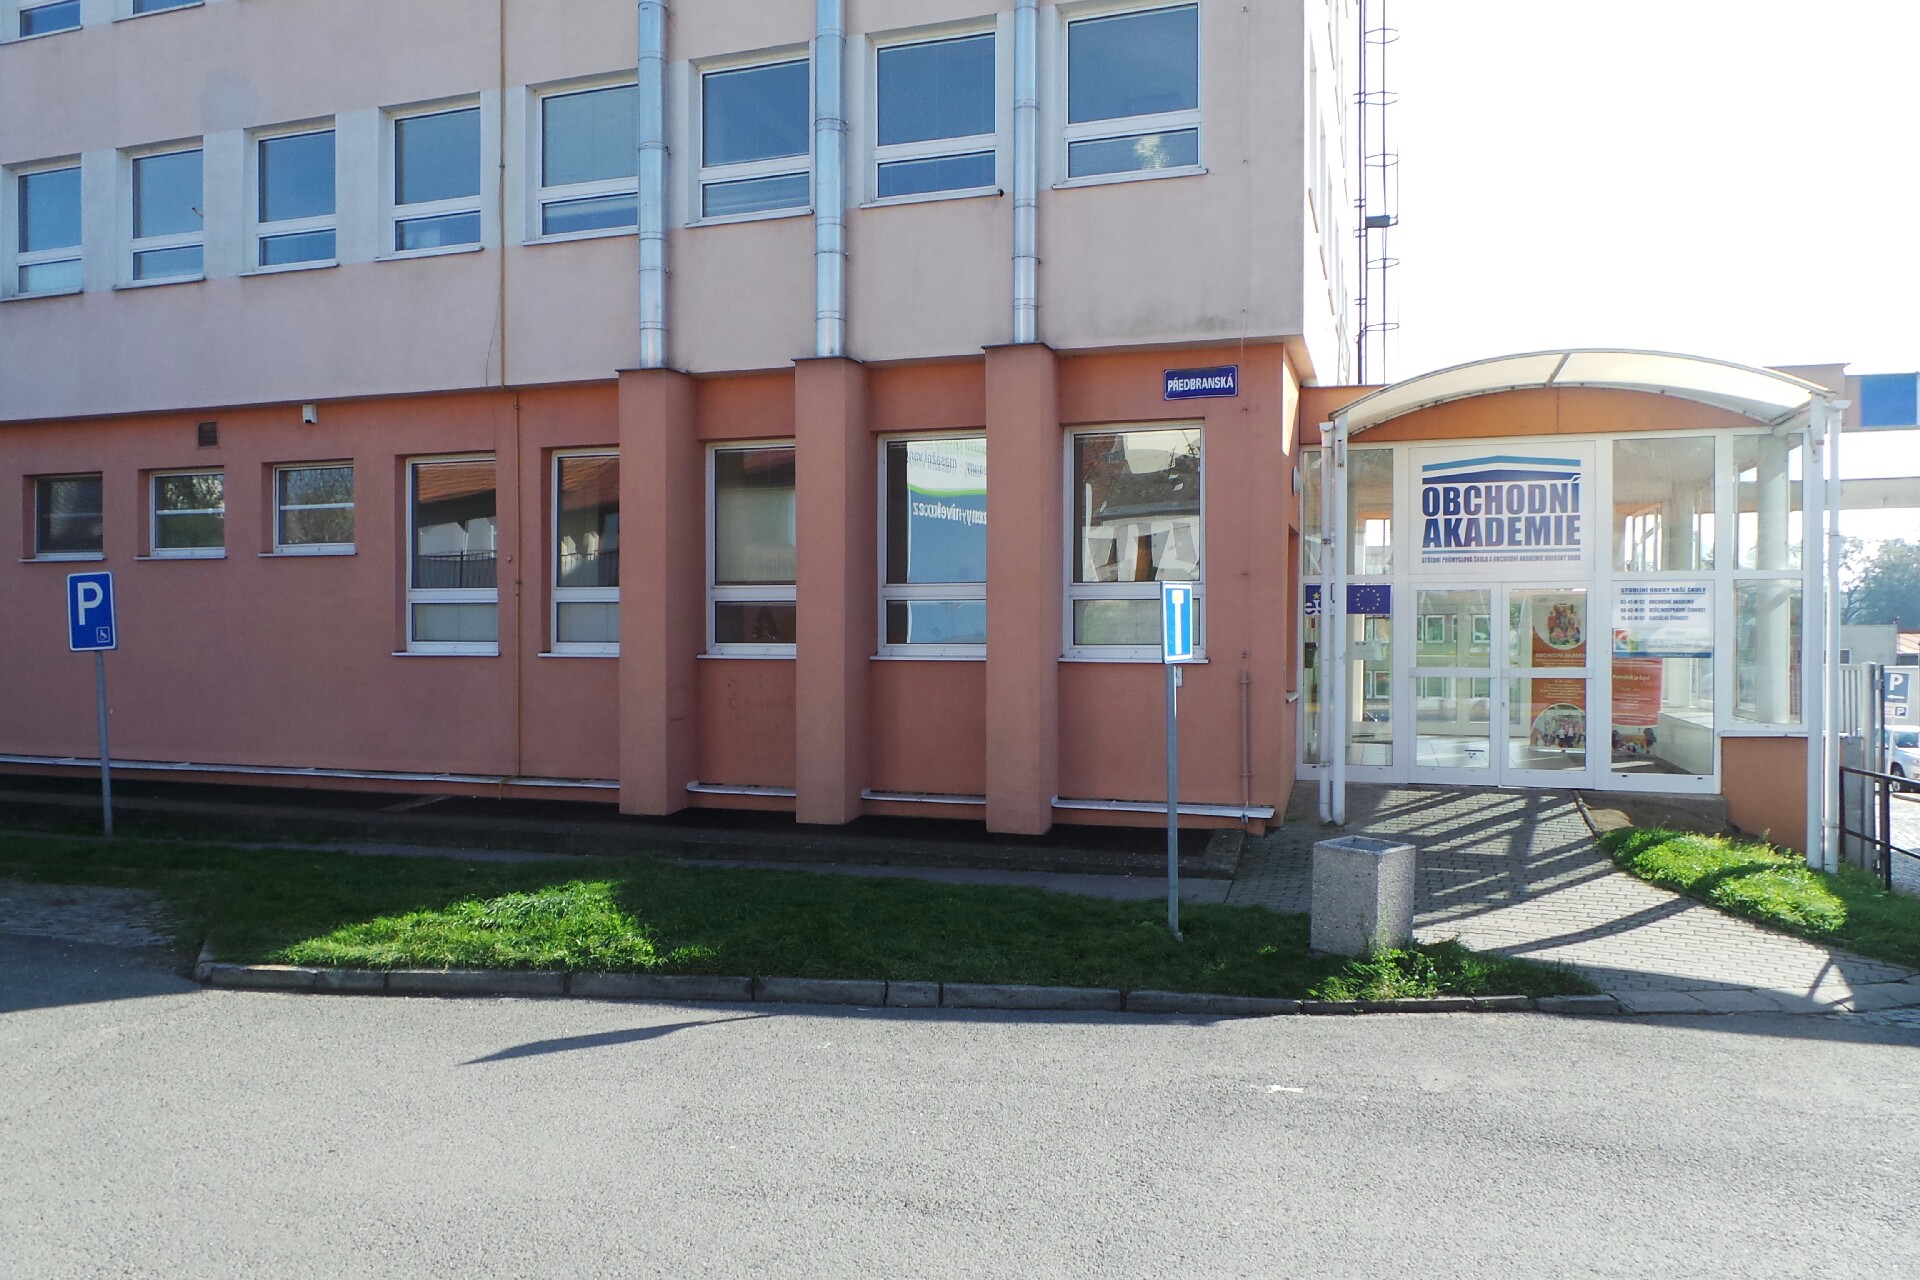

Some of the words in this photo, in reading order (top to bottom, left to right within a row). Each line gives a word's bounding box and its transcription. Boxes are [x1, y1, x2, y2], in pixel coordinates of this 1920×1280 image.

[1167, 373, 1234, 392] PŘEDBRANSKÁ
[1422, 475, 1581, 517] OBCHODNÍ
[1422, 515, 1581, 548] AKADEMIE
[77, 581, 103, 625] P
[1890, 674, 1904, 690] P
[1897, 707, 1905, 716] P
